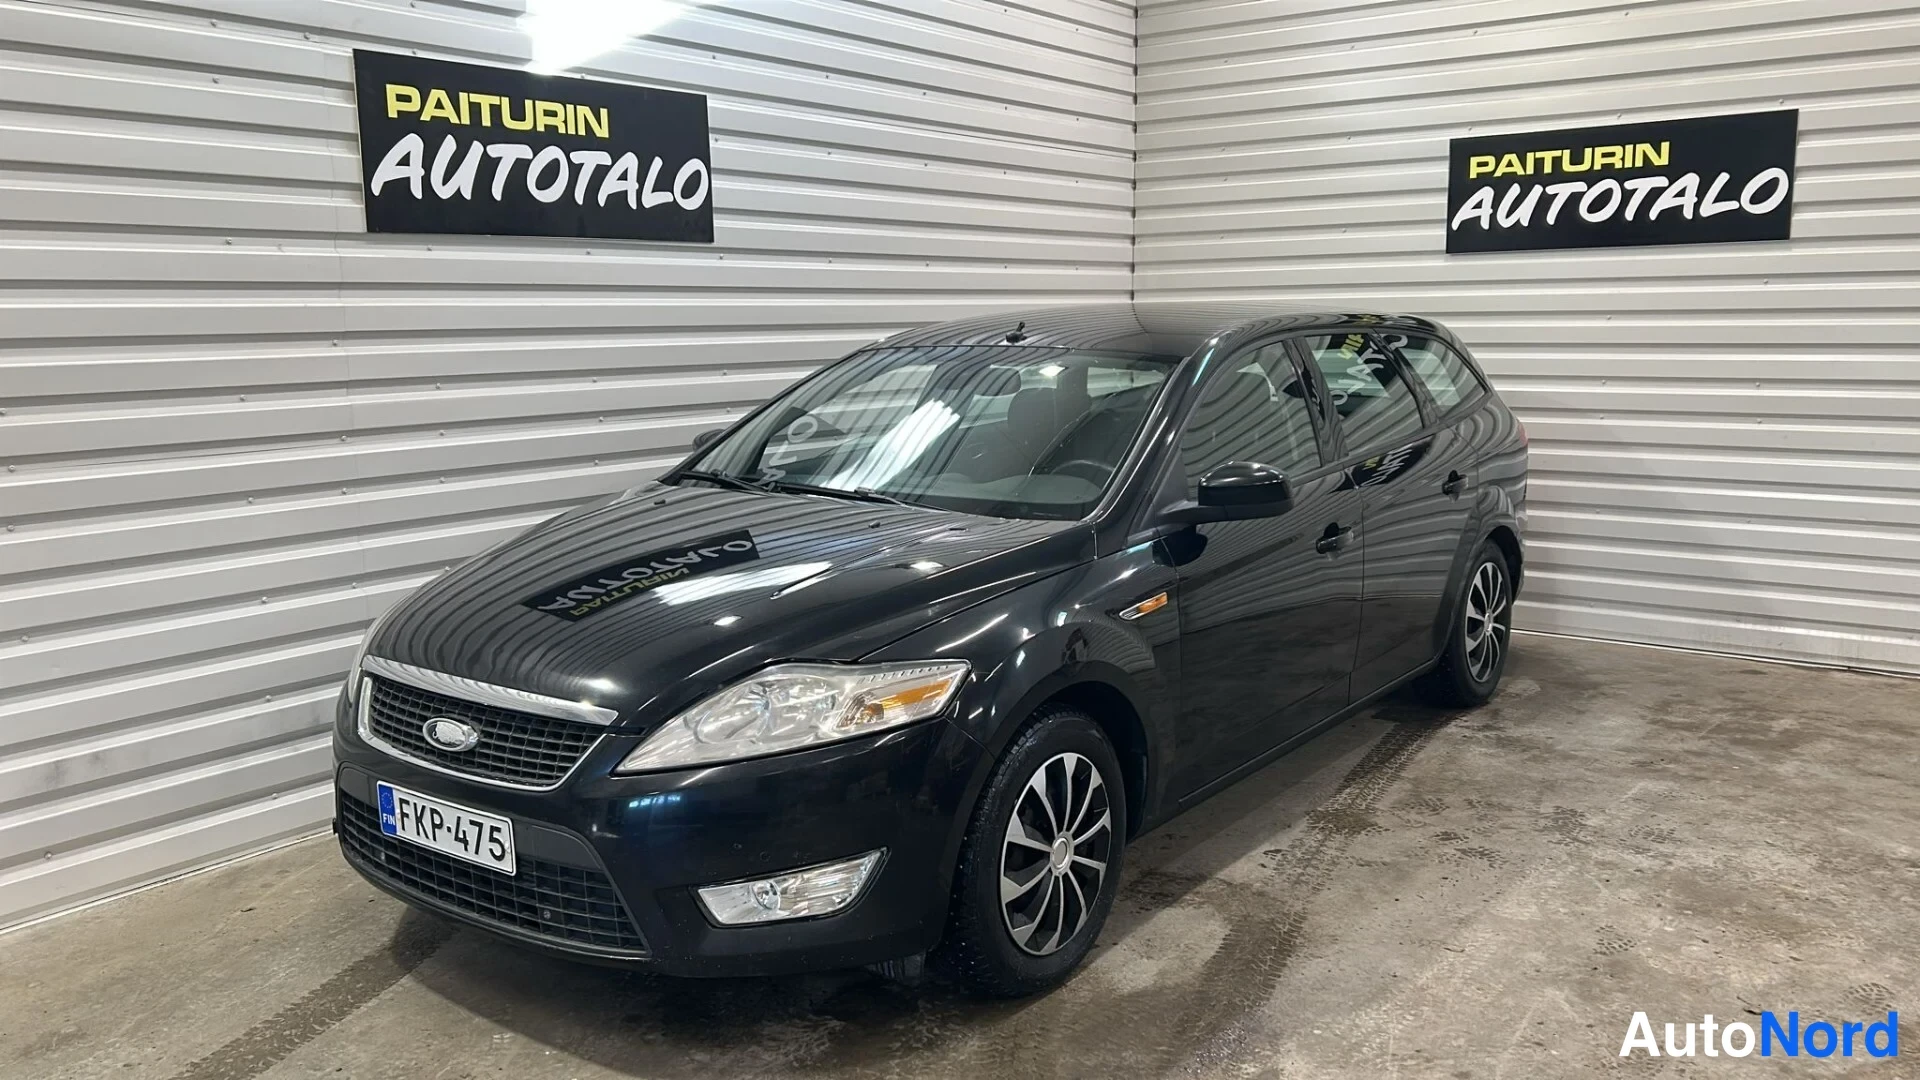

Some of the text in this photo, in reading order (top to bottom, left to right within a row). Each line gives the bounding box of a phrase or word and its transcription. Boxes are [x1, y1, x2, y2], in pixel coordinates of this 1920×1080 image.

[386, 84, 609, 138] PAITURIN
[371, 133, 709, 211] AUTOTALO
[1469, 142, 1670, 179] PAITURIN
[1451, 168, 1790, 231] AUTOTALO
[383, 813, 395, 825] FIN
